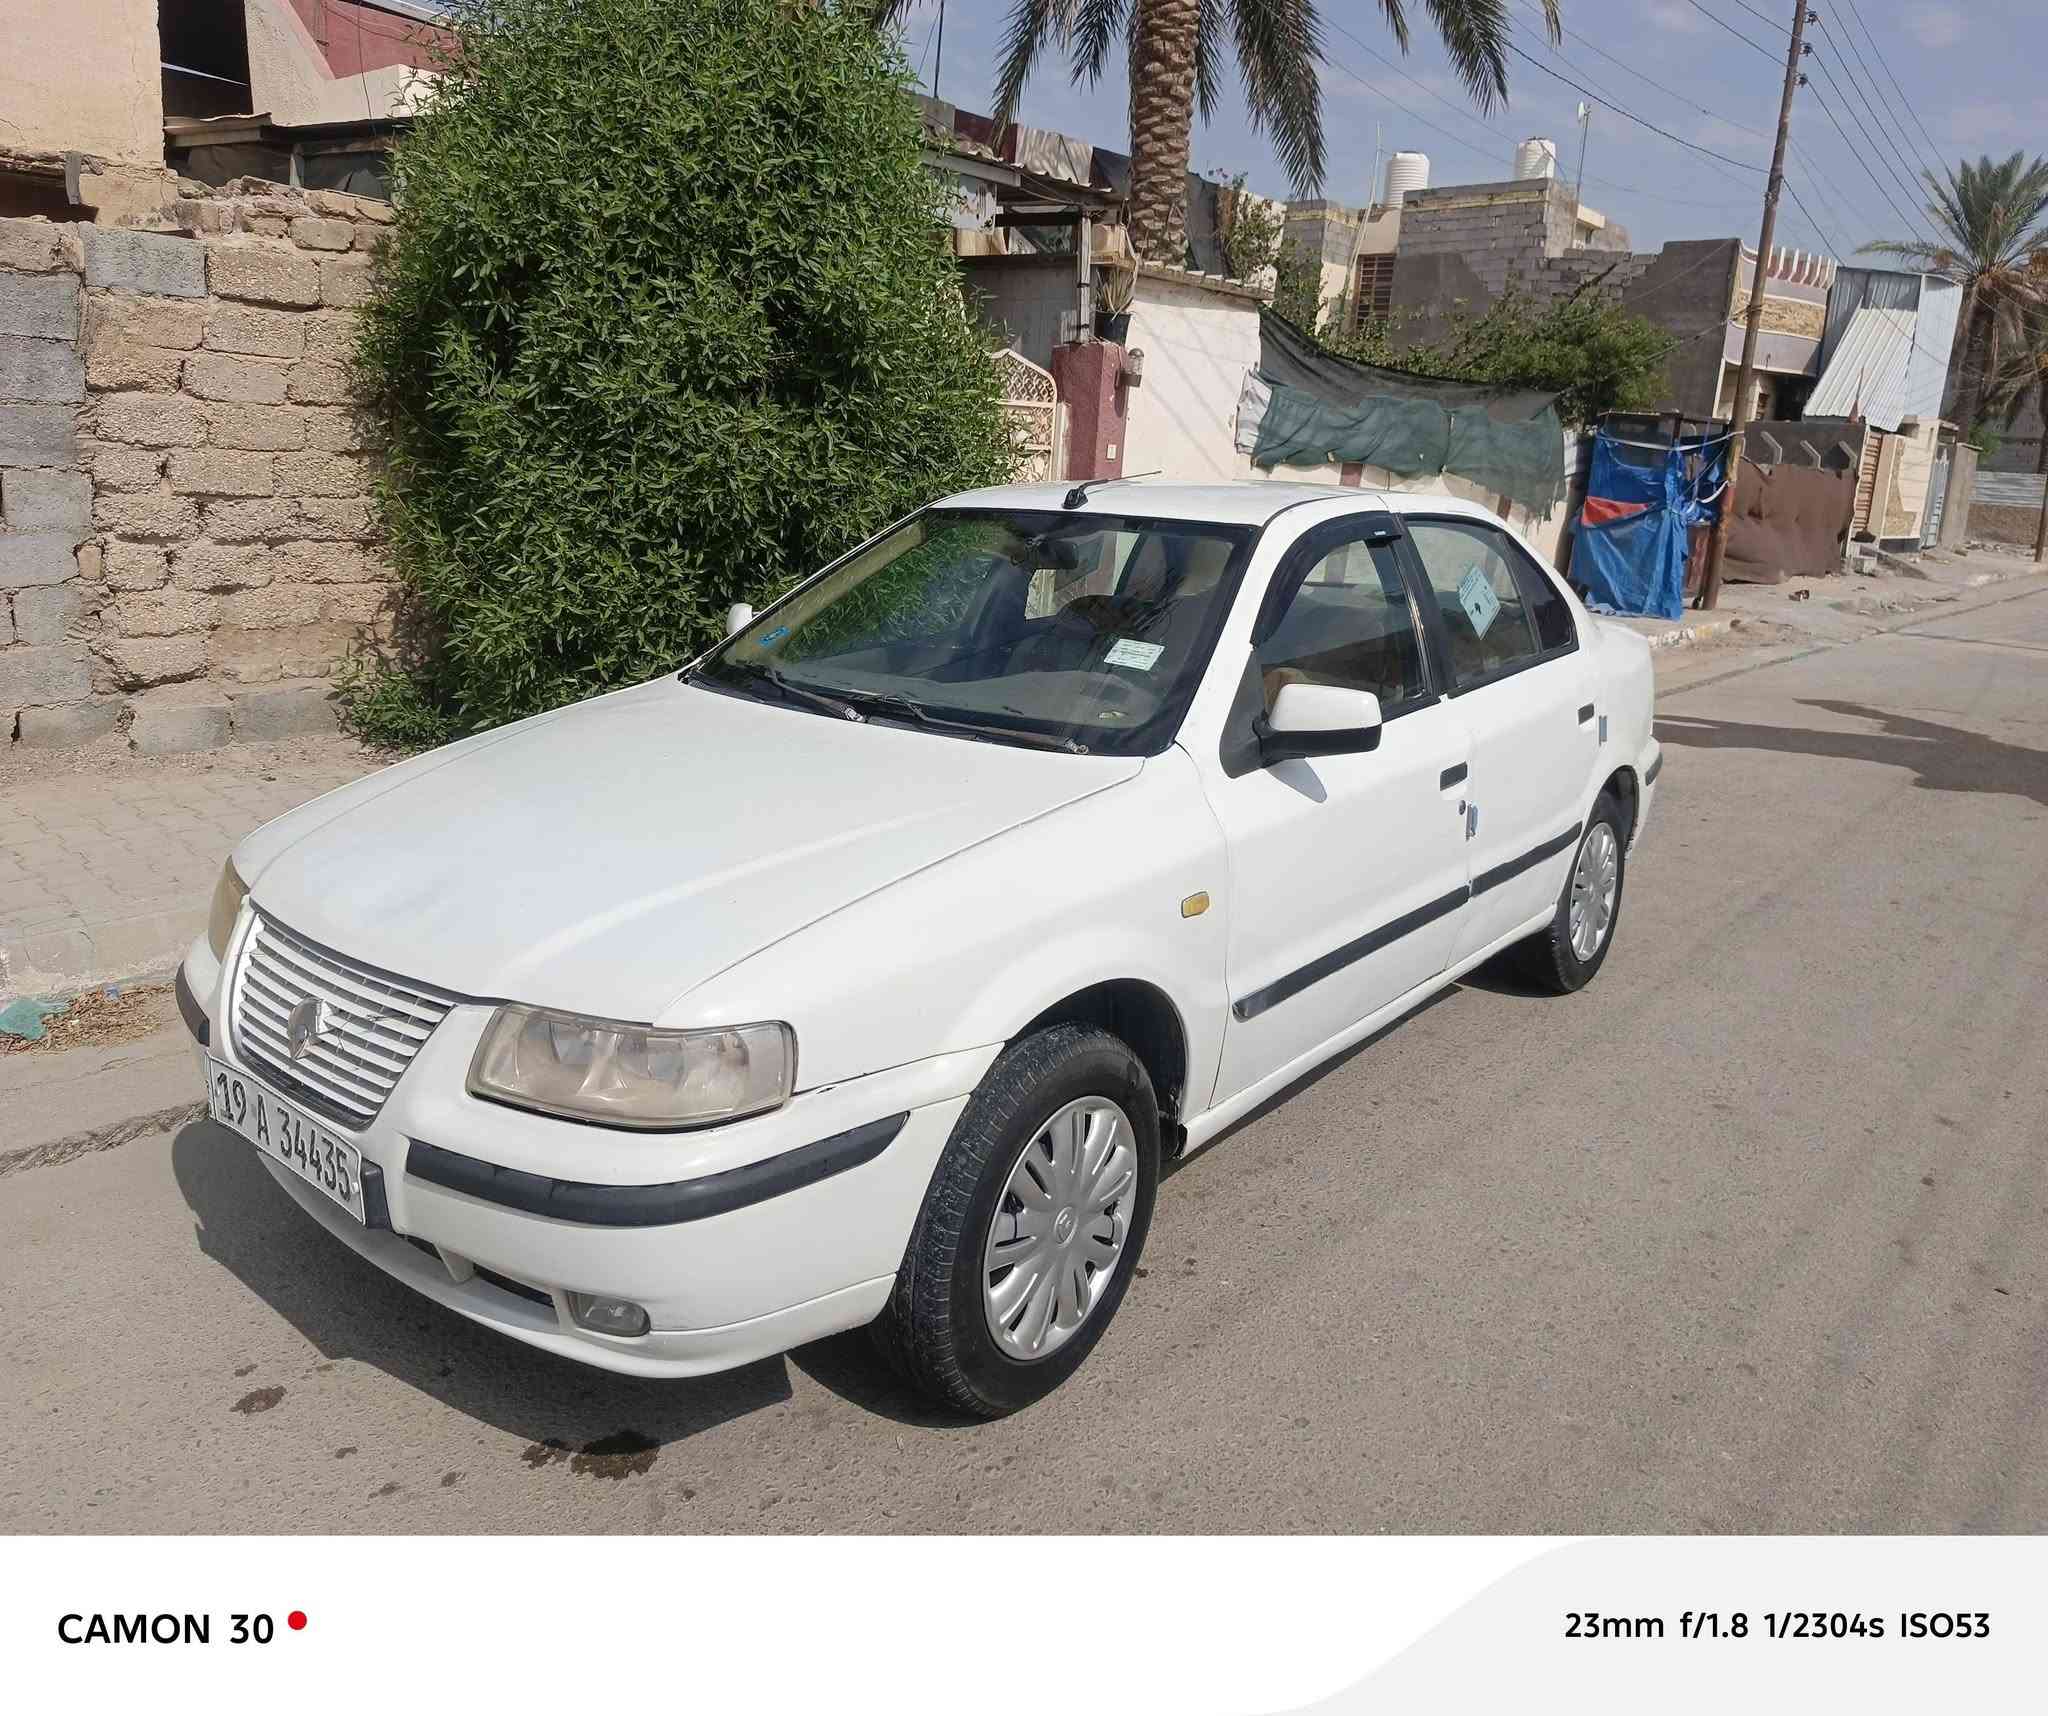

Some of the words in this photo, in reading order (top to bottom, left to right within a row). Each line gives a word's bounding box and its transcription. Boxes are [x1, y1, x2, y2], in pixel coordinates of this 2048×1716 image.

[216, 1072, 247, 1125] 19
[257, 1094, 270, 1145] A
[277, 1107, 350, 1201] 34435
